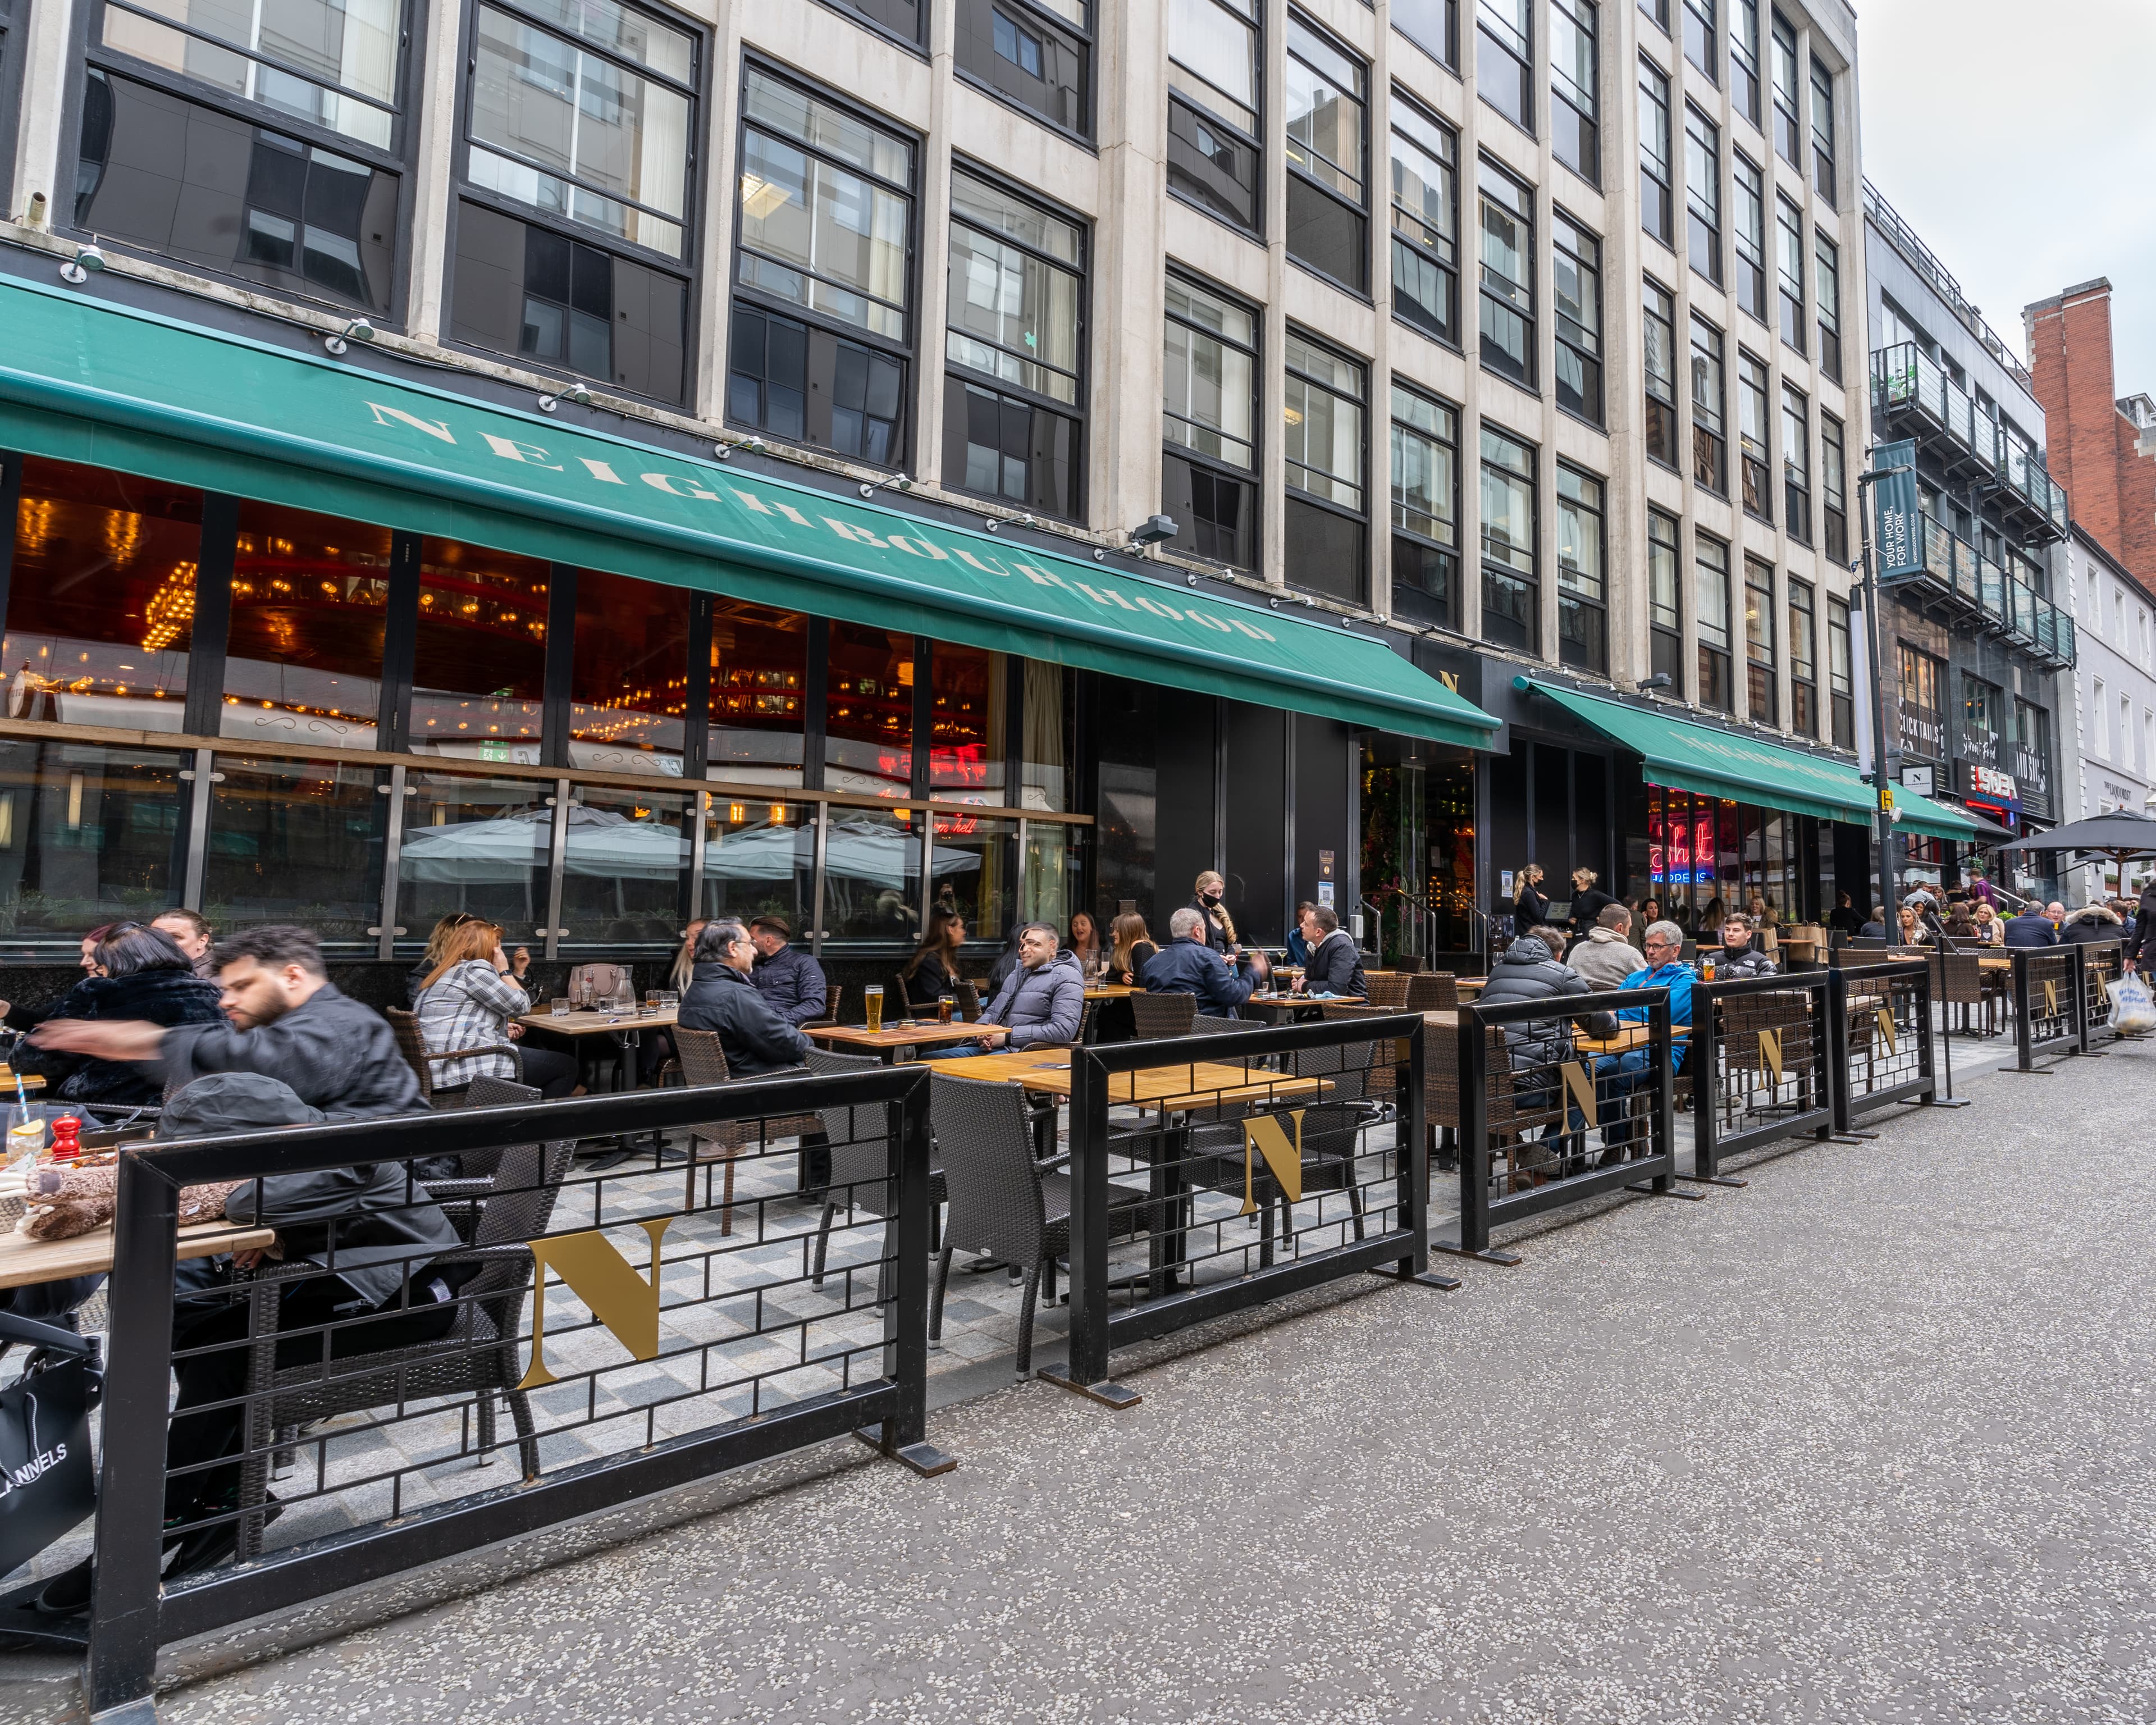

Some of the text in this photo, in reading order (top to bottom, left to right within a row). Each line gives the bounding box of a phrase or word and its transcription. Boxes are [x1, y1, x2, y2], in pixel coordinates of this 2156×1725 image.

[367, 400, 1276, 642] NEIGHBOURHOOD
[1884, 506, 1895, 569] YOUR HOME,
[1895, 512, 1906, 567] FOR WORK
[1439, 670, 1459, 694] N
[2109, 783, 2131, 802] LIQUORIST
[2044, 980, 2057, 1018] N
[1757, 1028, 1783, 1089] N
[1877, 1007, 1896, 1060] N
[1560, 1058, 1598, 1135] N
[1239, 1110, 1306, 1215] N
[517, 1217, 674, 1390] N
